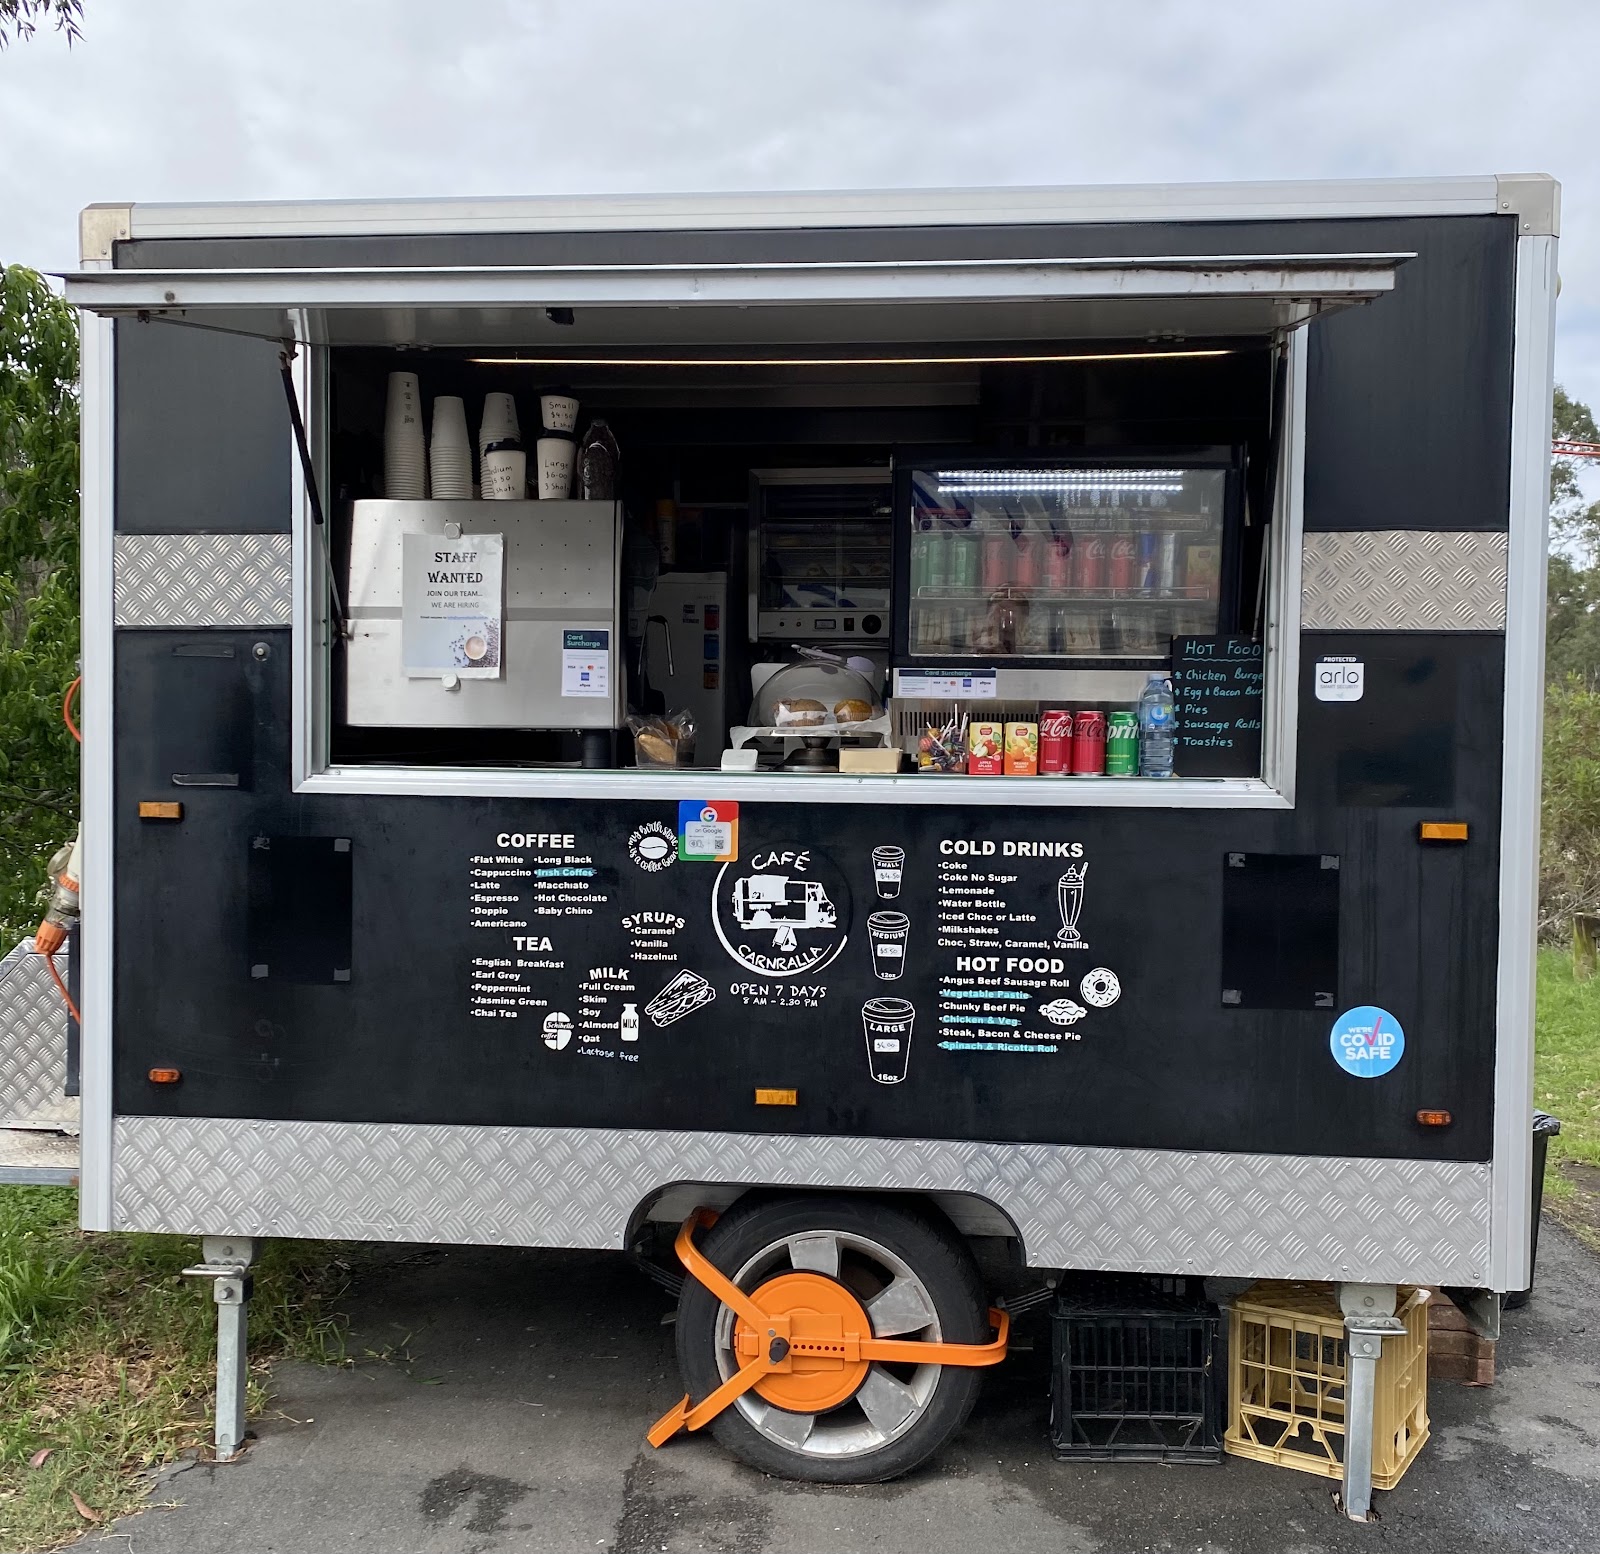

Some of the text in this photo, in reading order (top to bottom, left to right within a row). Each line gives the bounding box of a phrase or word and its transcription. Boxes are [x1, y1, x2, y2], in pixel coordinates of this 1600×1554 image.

[549, 401, 574, 410] Small
[551, 411, 573, 419] $4.50
[545, 459, 568, 470] Large
[434, 552, 477, 563] STAFF
[427, 570, 483, 583] WANTED
[1185, 640, 1261, 656] HOT FOOD
[1186, 669, 1226, 681] Chicken
[1320, 666, 1359, 683] arlo
[1184, 687, 1202, 700] Egg
[1213, 686, 1240, 696] Bacon
[1185, 704, 1208, 714] Pies
[1184, 719, 1261, 734] Sausage Rolls
[1183, 736, 1233, 747] Toasties
[703, 810, 714, 822] G
[497, 833, 574, 848] COFFEE
[628, 831, 642, 846] my
[940, 840, 1083, 857] COLD DRINKS
[538, 856, 561, 865] Long
[640, 861, 663, 872] coffee
[662, 851, 678, 867] bean
[752, 851, 810, 871] CAFÉ
[474, 869, 531, 878] Cappuccino
[941, 873, 968, 881] Coke
[988, 874, 1017, 883] Sugar
[941, 886, 994, 894] Lemonade
[475, 894, 519, 903] Espresso
[975, 900, 1006, 908] Bottle
[475, 907, 508, 916] Doppio
[537, 907, 562, 916] Baby
[941, 912, 964, 920] Iced
[621, 912, 685, 930] SYRUPS
[635, 927, 675, 935] Caramel
[872, 931, 905, 939] MEDIUM
[941, 926, 999, 934] Milkshakes
[513, 937, 553, 951] TEA
[938, 939, 1089, 949] Choc, Straw, Caramel, Vanilla
[738, 945, 823, 970] CARNRALLA
[475, 958, 564, 968] English Breakfast
[957, 957, 1064, 973] HOT FOOD
[498, 972, 520, 981] Grey
[589, 967, 629, 980] MILK
[604, 983, 635, 991] Cream
[942, 976, 1069, 988] Angus Beef Sausage Roll
[474, 984, 530, 993] Peppermint
[730, 983, 827, 997] OPEN 7 DAYS
[583, 995, 607, 1003] Skim
[943, 990, 994, 999] Vegetable
[474, 996, 547, 1006] Jasmine Green
[804, 999, 817, 1007] PM
[943, 1002, 1025, 1012] Chunky Beef Pie
[583, 1008, 600, 1017] Soy
[623, 1019, 638, 1029] MILK
[943, 1015, 984, 1024] Chicken
[581, 1021, 619, 1029] Almond
[870, 1023, 905, 1033] LARGE
[941, 1028, 975, 1038] Steak,
[978, 1029, 1009, 1037] Bacon
[1024, 1031, 1062, 1040] Cheese
[1065, 1032, 1081, 1040] Pie
[943, 1041, 983, 1050] Spinach
[986, 1042, 995, 1050] &
[998, 1043, 1035, 1052] Ricotta
[581, 1047, 639, 1062] Lactose free
[1346, 1047, 1391, 1060] SAFE
